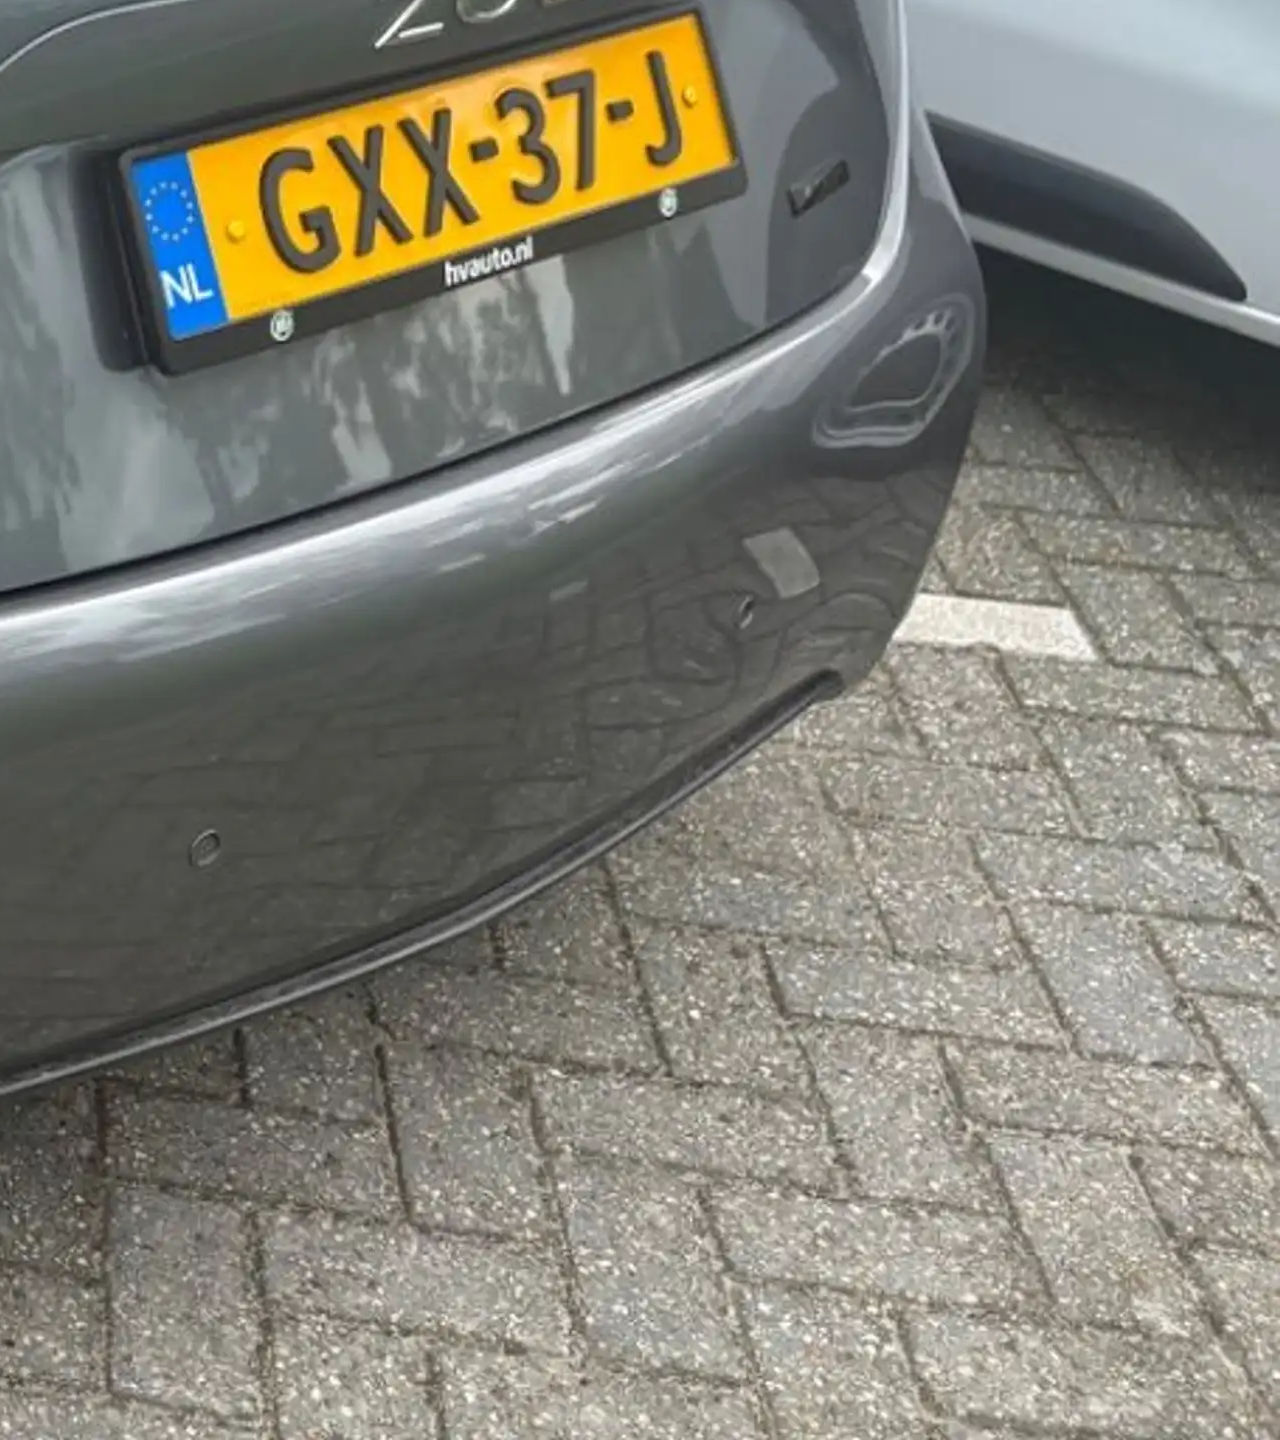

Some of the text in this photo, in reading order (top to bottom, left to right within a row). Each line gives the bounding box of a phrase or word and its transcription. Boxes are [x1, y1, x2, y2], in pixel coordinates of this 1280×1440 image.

[160, 50, 683, 310] NL GXX-37-J
[444, 235, 534, 288] hvauto.nl
